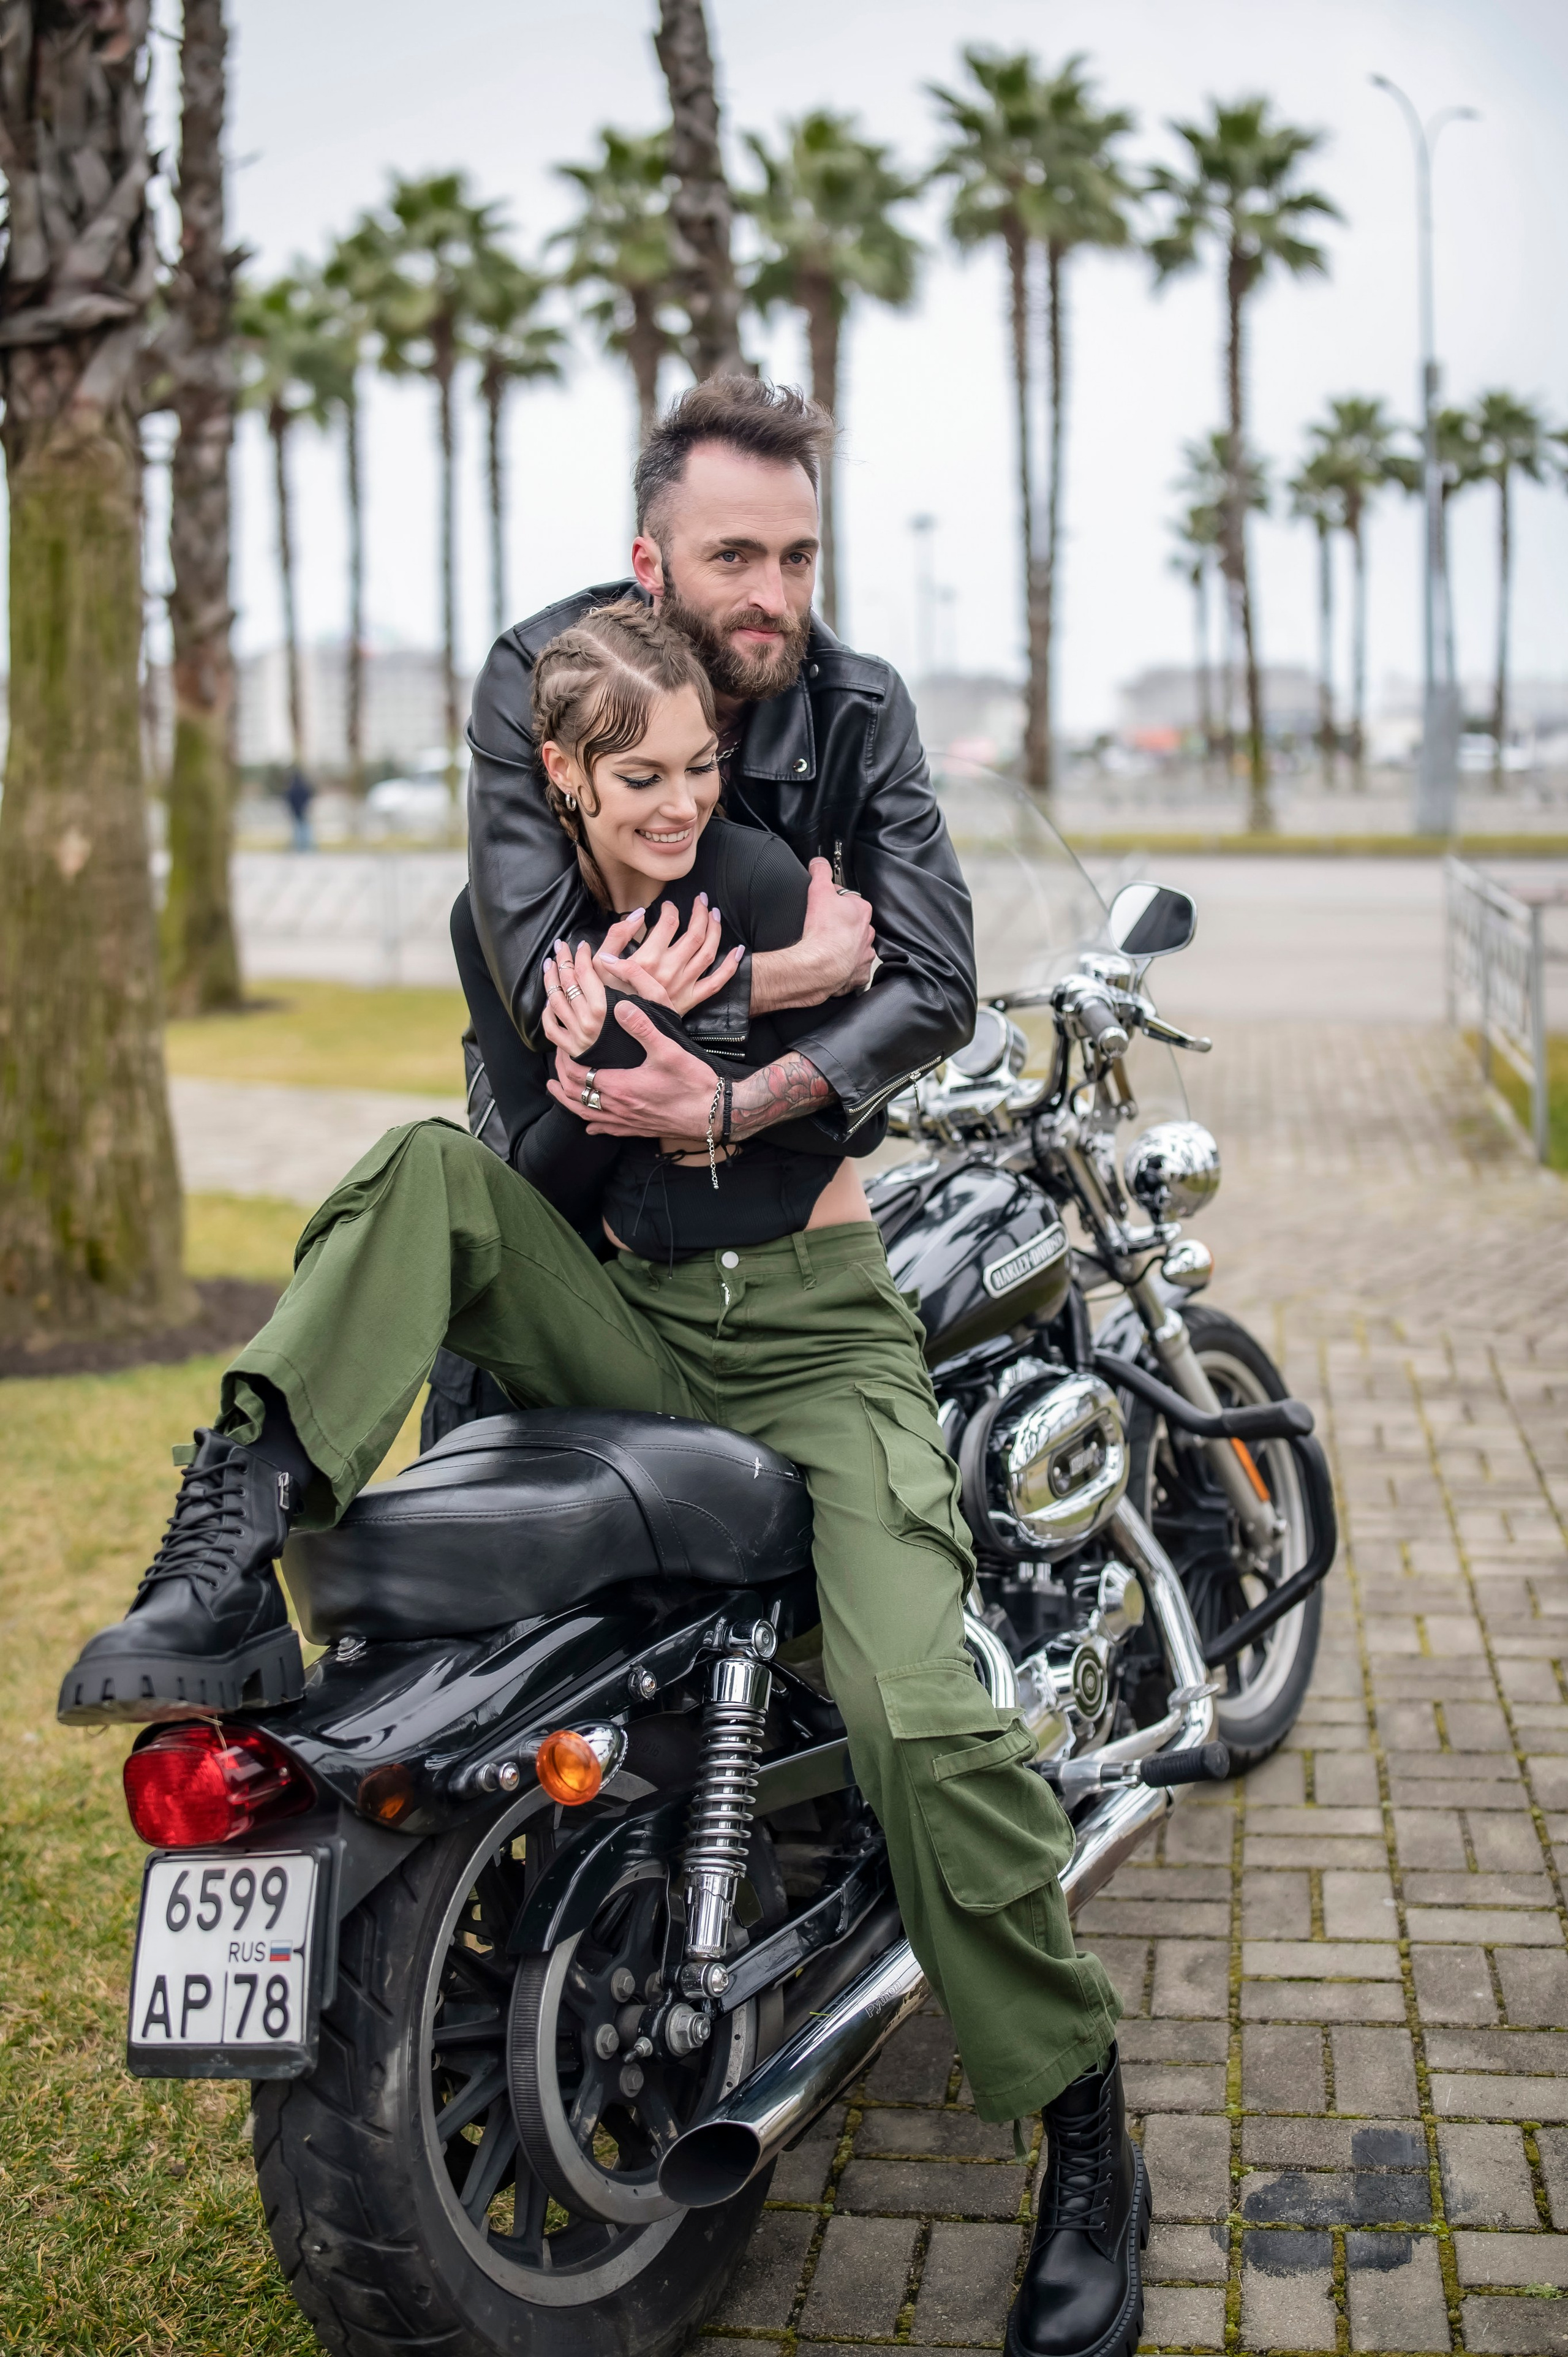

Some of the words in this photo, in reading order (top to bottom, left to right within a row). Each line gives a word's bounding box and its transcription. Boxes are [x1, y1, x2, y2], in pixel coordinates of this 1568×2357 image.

[167, 1866, 288, 1931] 6599
[228, 1942, 266, 1963] RUS
[141, 1974, 213, 2038] AP
[233, 1974, 290, 2038] 78
[865, 1980, 902, 2018] Python
